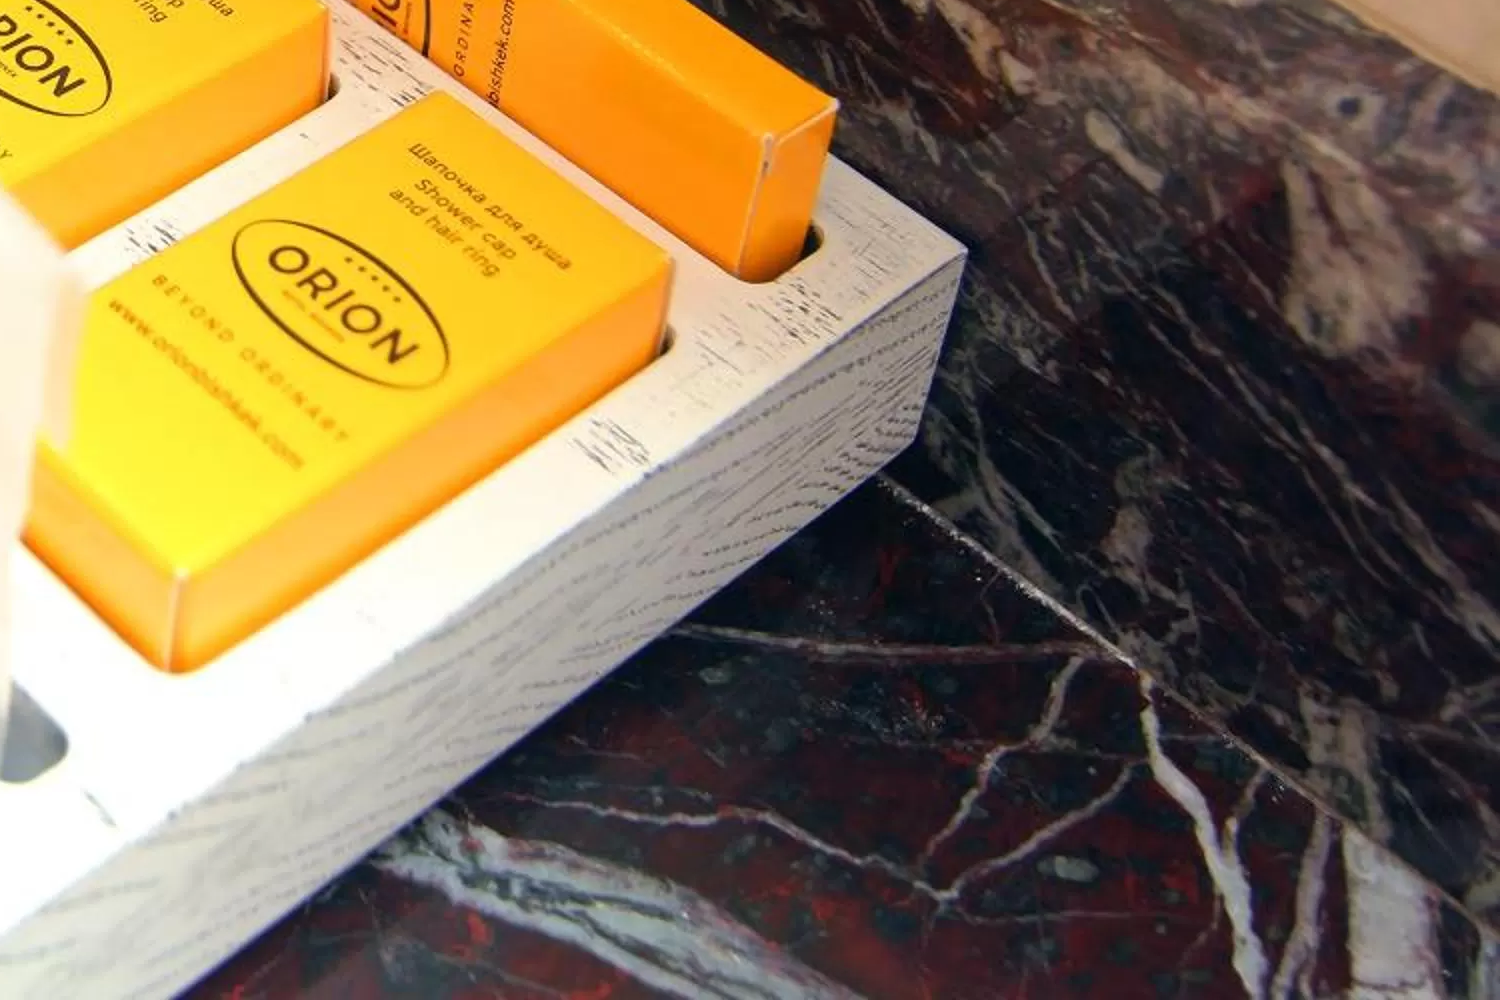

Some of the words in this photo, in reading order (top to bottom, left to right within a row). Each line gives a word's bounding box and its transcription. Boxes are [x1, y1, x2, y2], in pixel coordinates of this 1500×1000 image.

[388, 190, 427, 217] and
[424, 212, 463, 245] hair
[461, 244, 500, 277] ring
[408, 142, 487, 203] Шапочка
[485, 204, 523, 232] для
[521, 232, 571, 270] душа
[414, 178, 482, 233] Shower
[482, 232, 516, 261] cap
[152, 273, 235, 344] BEYOND
[239, 347, 350, 444] ORDINARY
[268, 245, 420, 366] ORION
